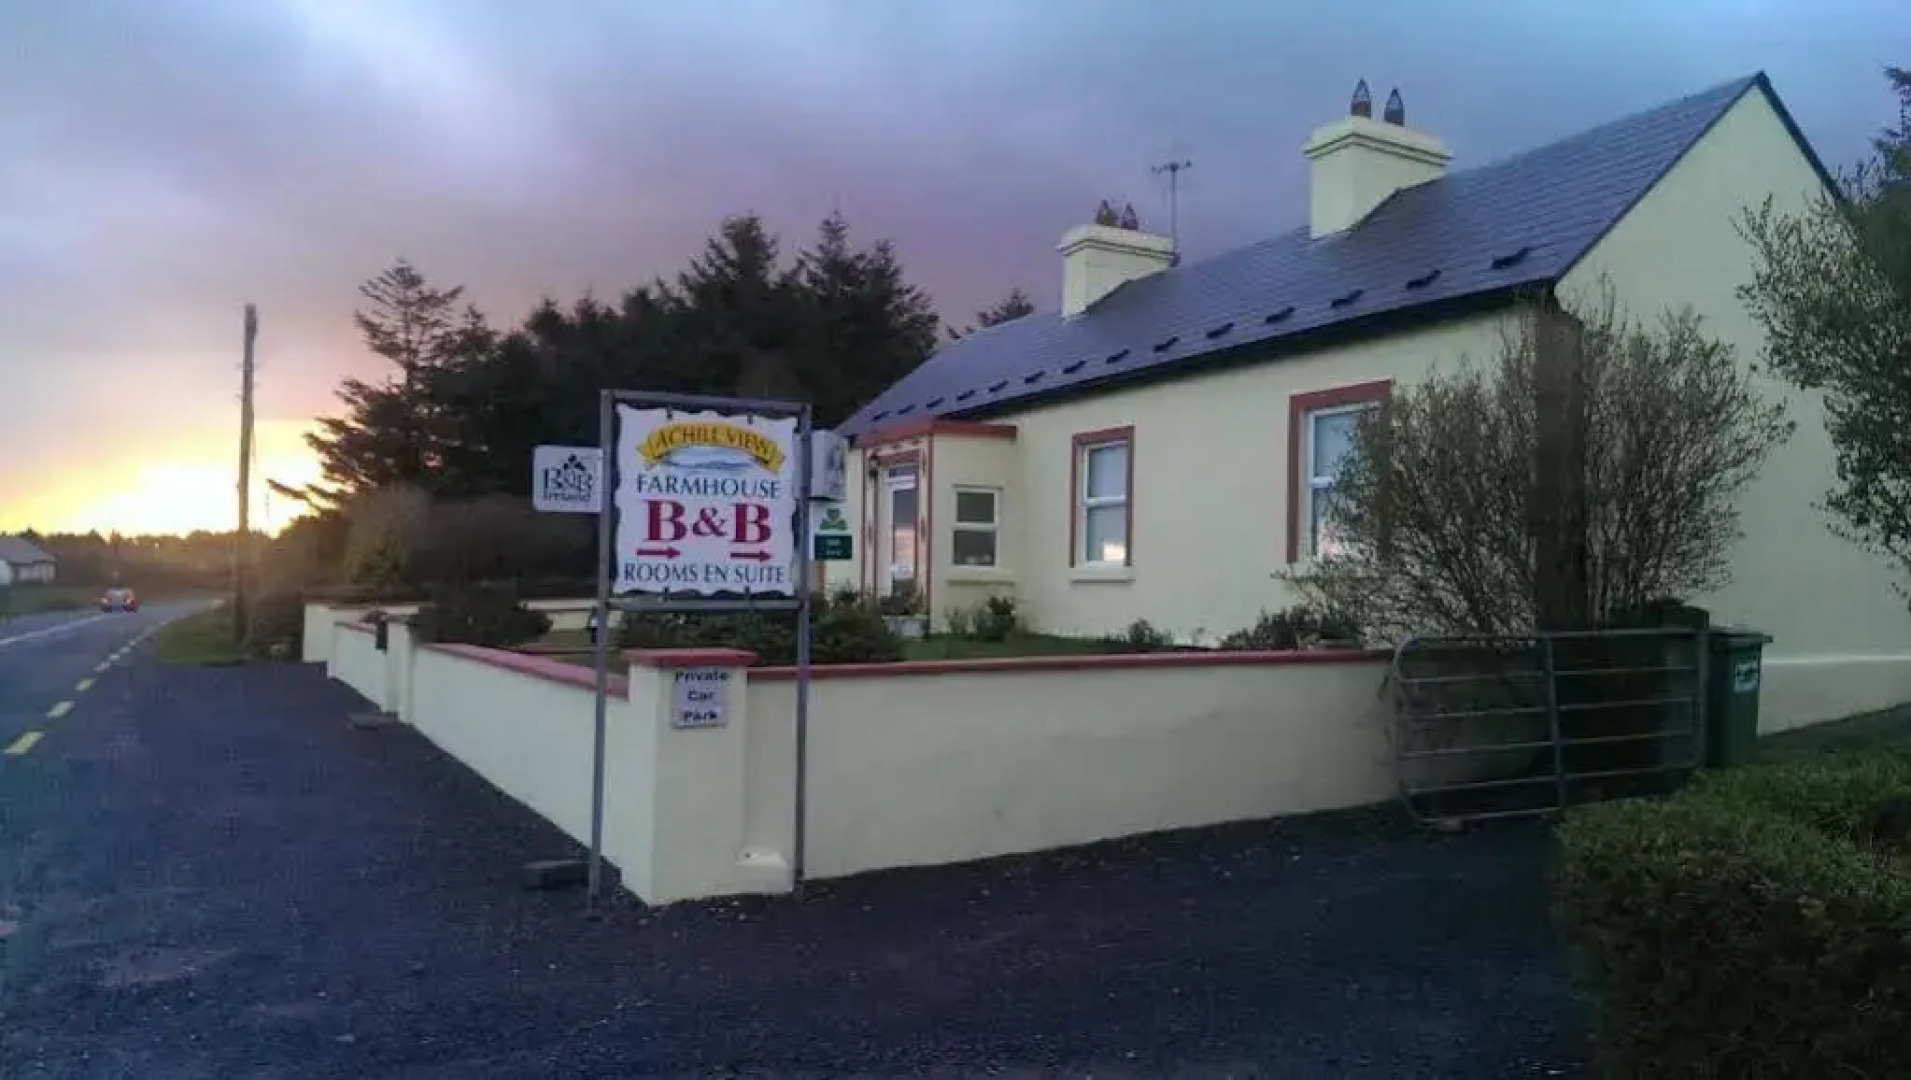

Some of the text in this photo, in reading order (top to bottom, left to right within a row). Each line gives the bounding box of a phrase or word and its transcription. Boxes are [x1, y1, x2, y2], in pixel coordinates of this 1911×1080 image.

[655, 424, 771, 456] ACHILL VIEW
[637, 473, 781, 499] FARMHOUSE
[643, 499, 772, 544] B&B
[624, 562, 785, 584] ROOMS EN SUITE
[674, 670, 730, 682] Private
[687, 690, 714, 701] Car
[683, 710, 718, 721] Park
